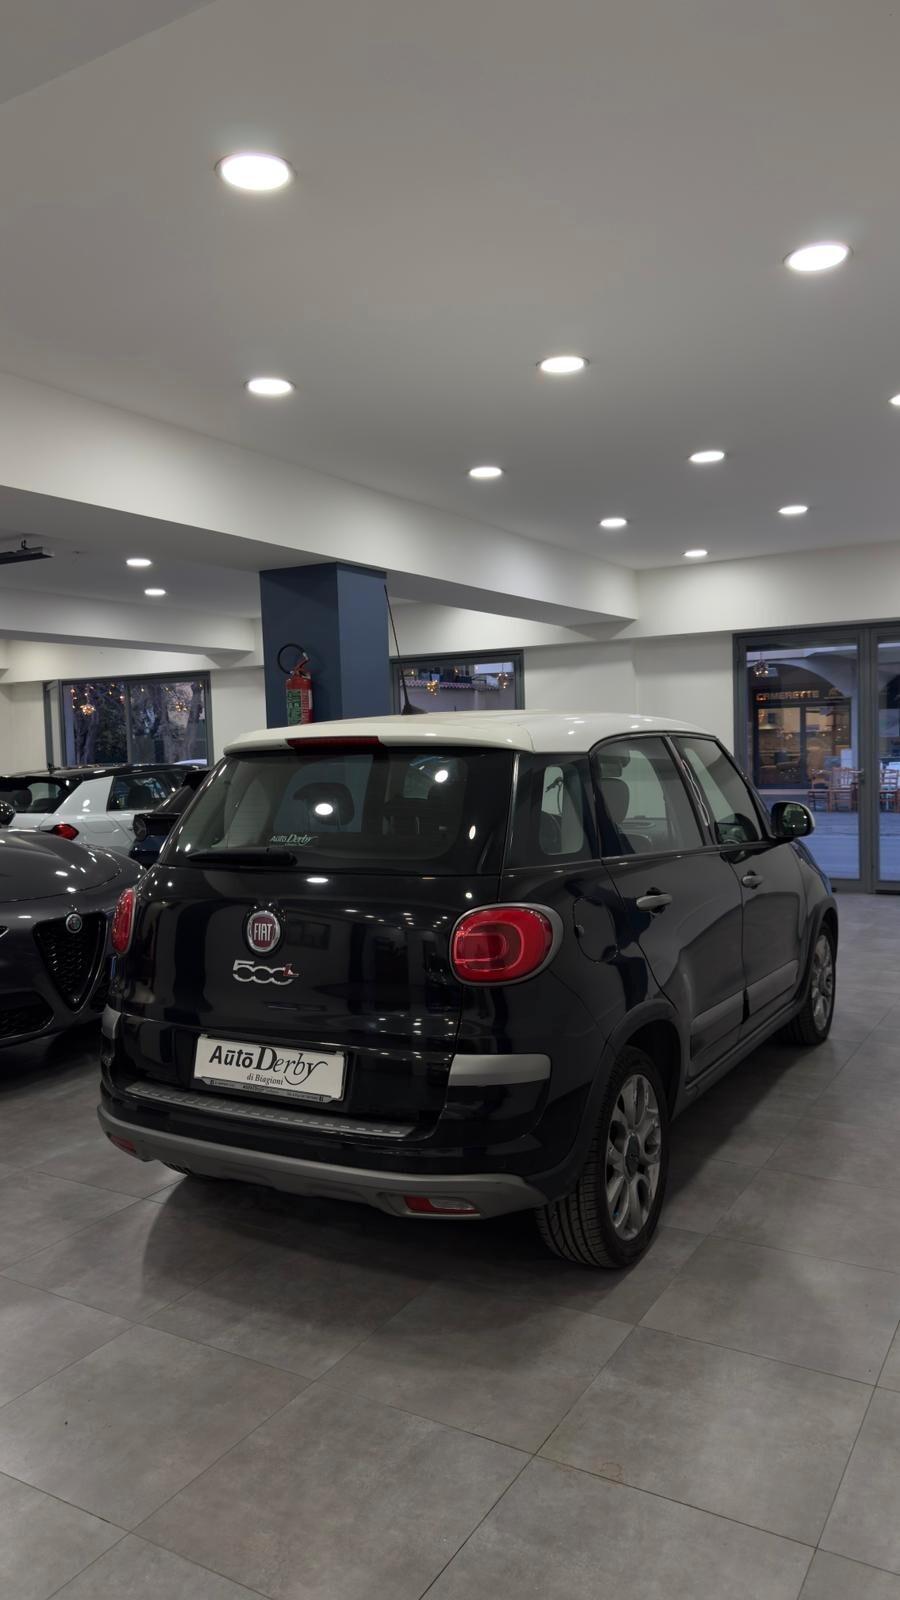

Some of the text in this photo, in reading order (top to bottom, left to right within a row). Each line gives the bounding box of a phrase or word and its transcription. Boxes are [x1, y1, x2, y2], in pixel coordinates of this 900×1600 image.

[253, 923, 273, 941] FIAT
[246, 1073, 284, 1086] di Biagioni
